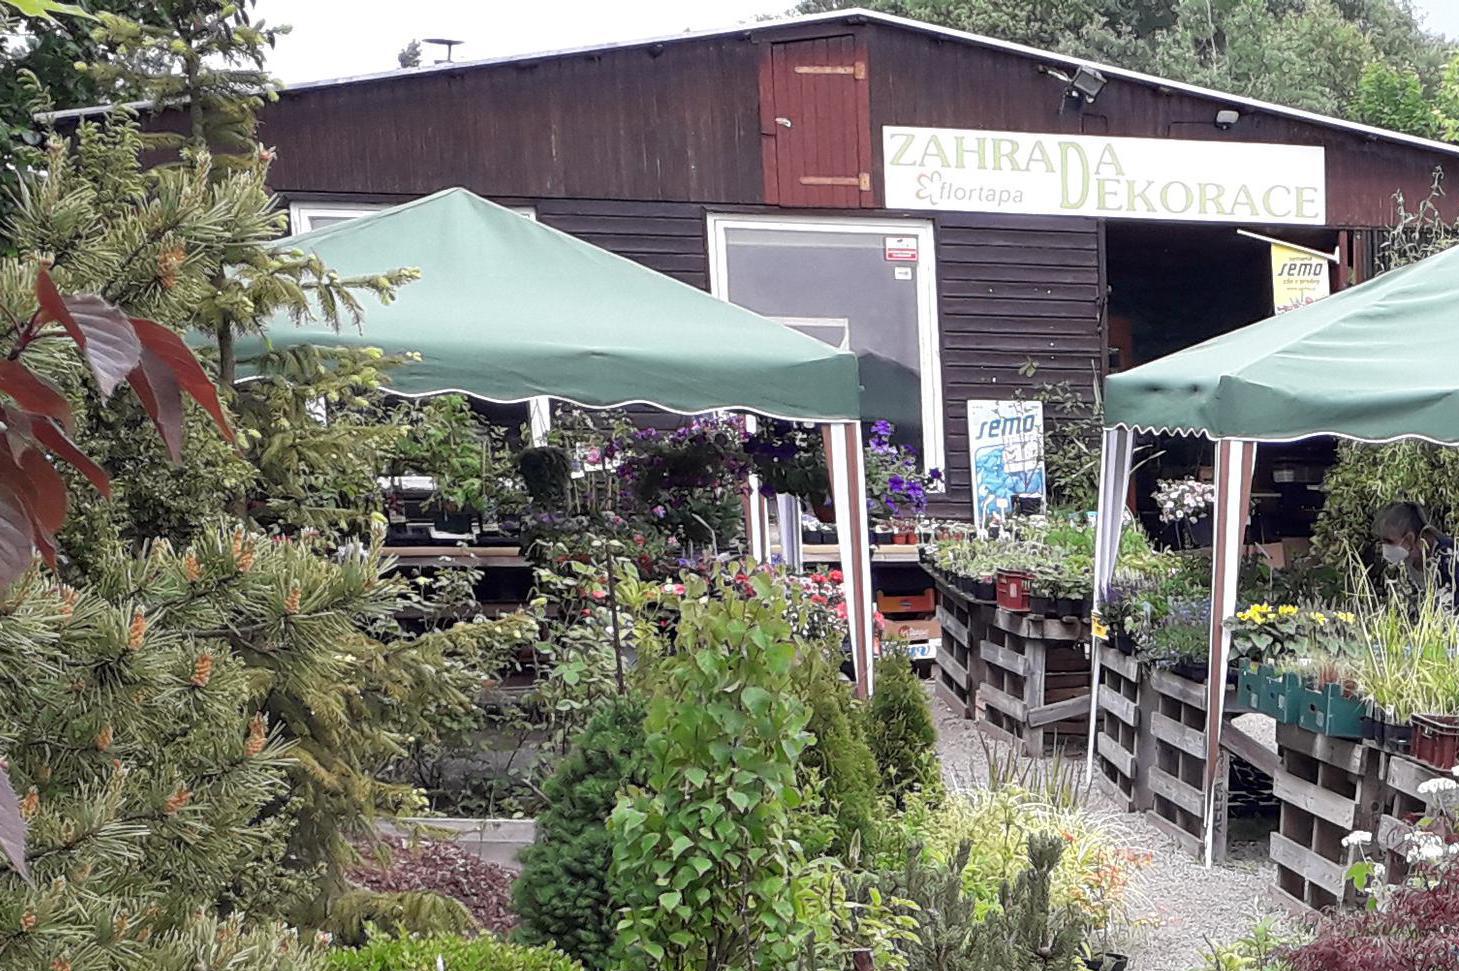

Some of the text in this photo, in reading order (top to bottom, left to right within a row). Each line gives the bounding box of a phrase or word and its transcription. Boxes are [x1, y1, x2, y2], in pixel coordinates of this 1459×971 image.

[889, 133, 1125, 209] ZAHRADA
[940, 182, 1024, 206] flortapa
[1278, 262, 1323, 277] semo
[975, 414, 1035, 440] semo
